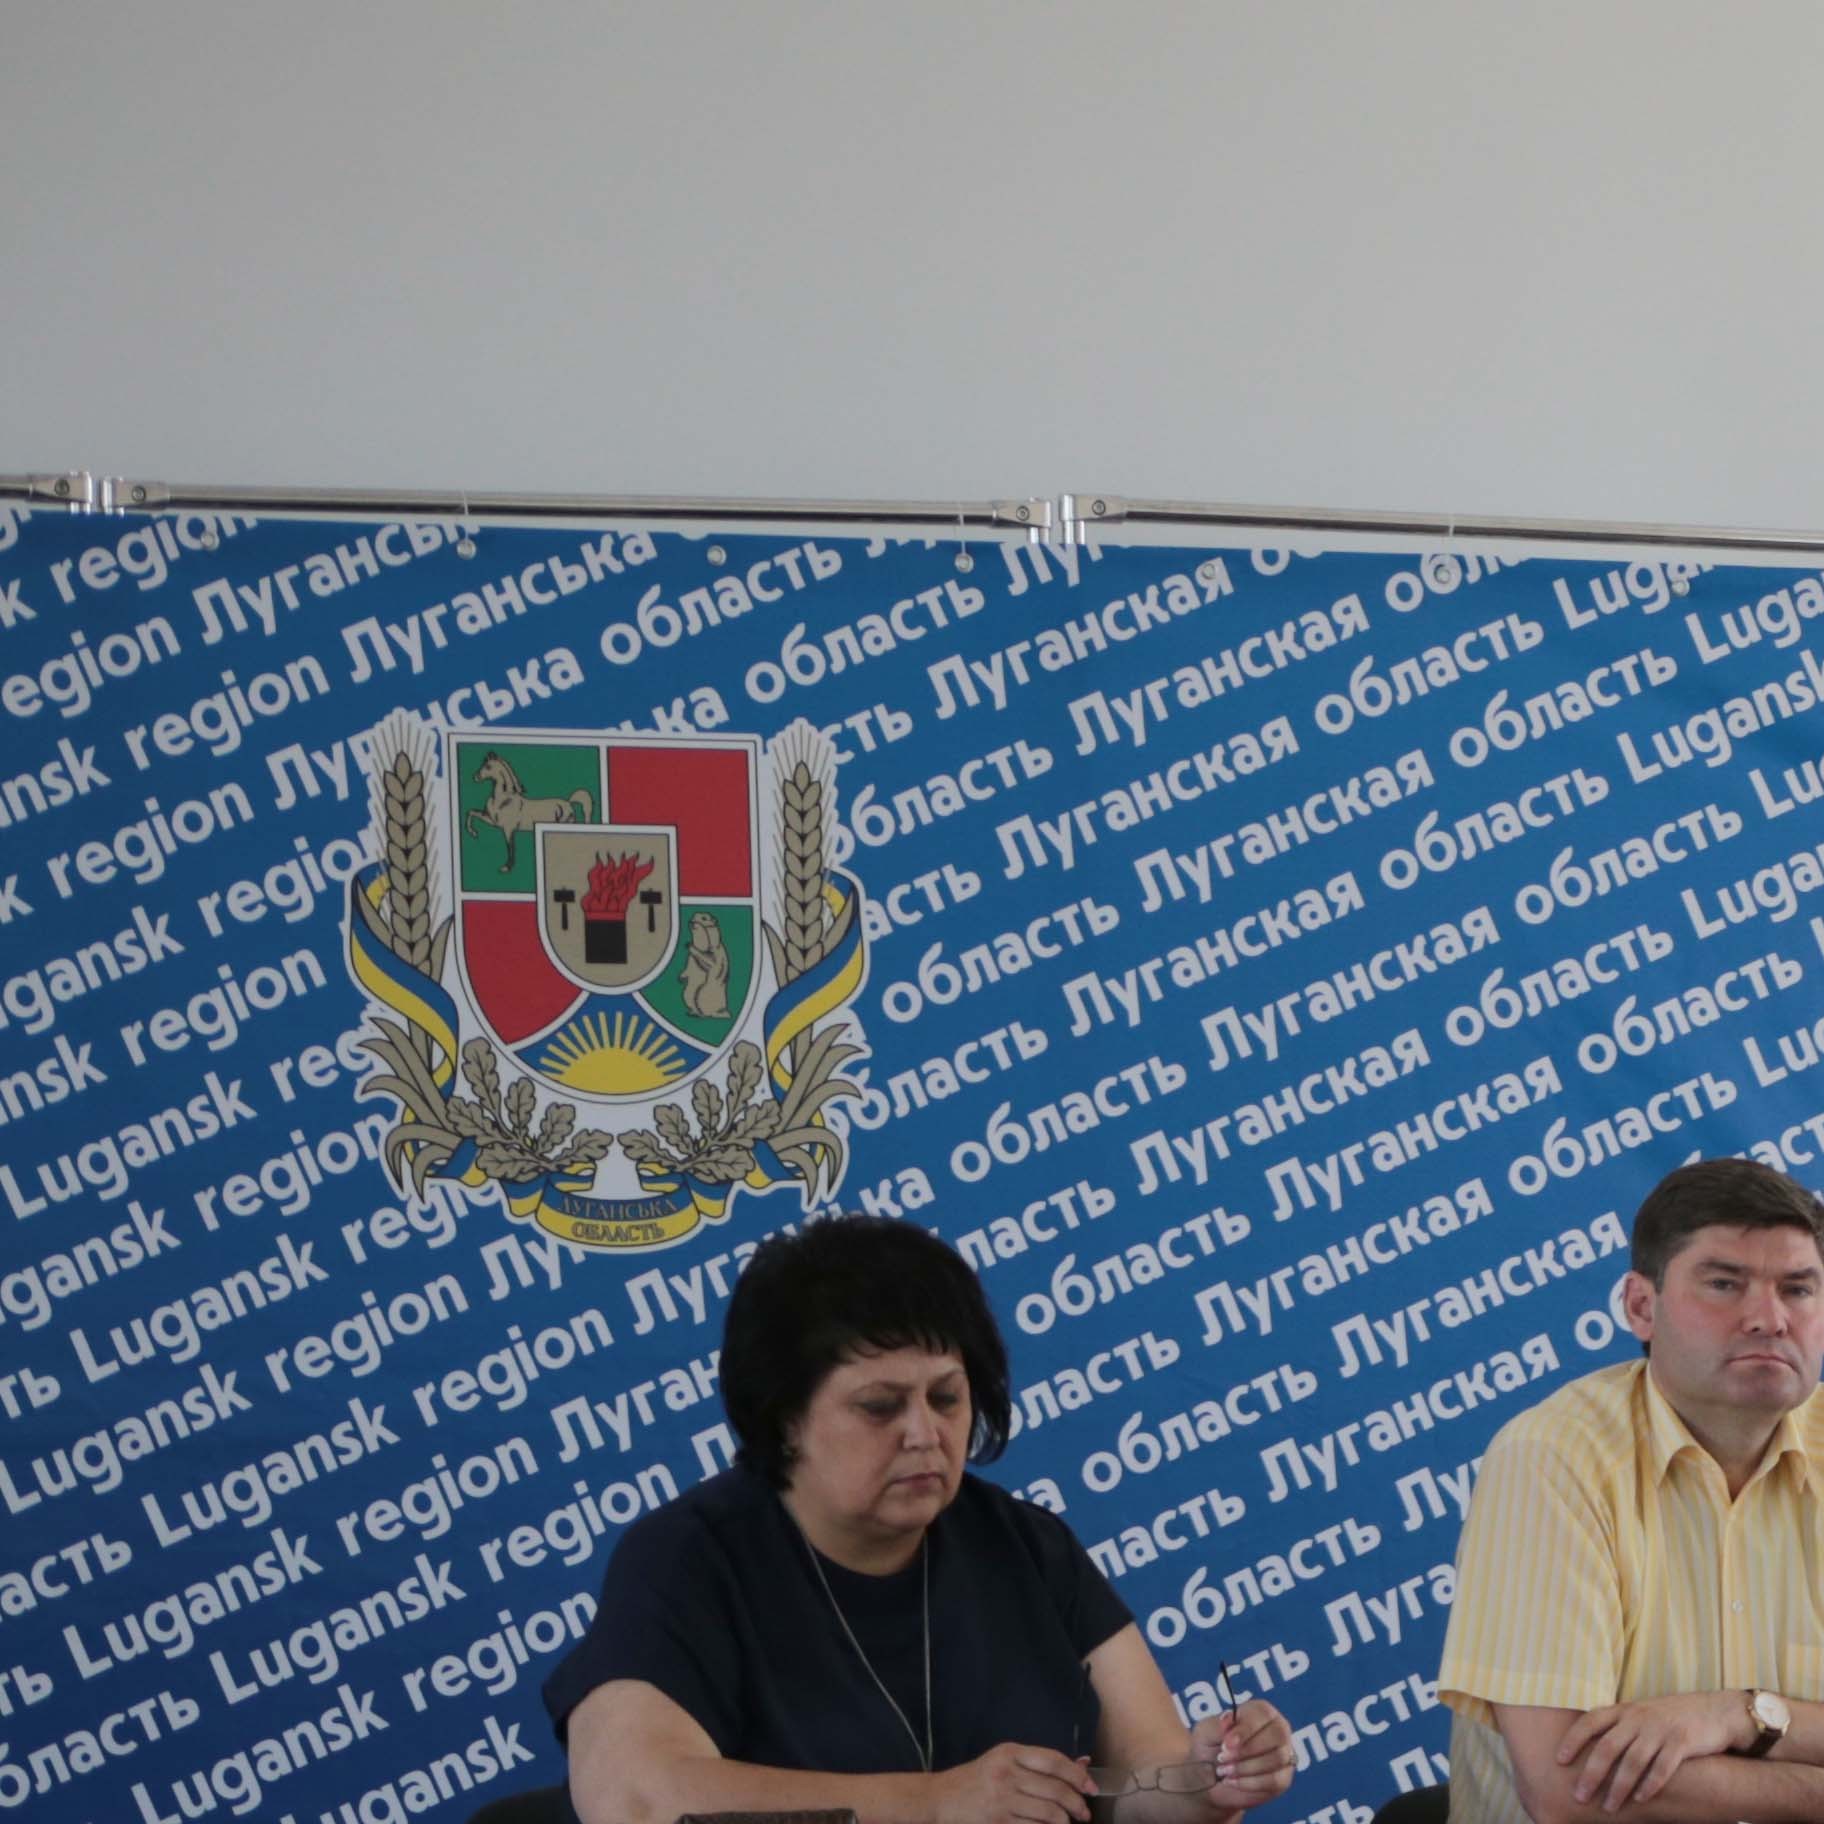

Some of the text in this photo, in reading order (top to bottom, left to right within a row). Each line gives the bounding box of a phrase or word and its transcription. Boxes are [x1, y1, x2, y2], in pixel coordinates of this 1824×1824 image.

[0, 906, 184, 1035] gansk
[745, 546, 985, 703] область
[0, 1072, 257, 1219] Lugansk
[1068, 594, 1370, 756] Луганская
[47, 783, 254, 897] region
[600, 542, 842, 665] область
[120, 949, 326, 1066] region
[927, 558, 1234, 719] Луганская
[124, 533, 656, 770] region Луганська
[0, 1200, 181, 1331] gansk
[996, 716, 1300, 880] Луганская
[1314, 613, 1544, 735] область
[0, 1363, 252, 1514] Lugansk
[265, 1274, 469, 1392] region
[1062, 872, 1365, 1037] Луганская
[1380, 768, 1609, 889] область
[70, 1233, 329, 1383] Lugansk
[882, 897, 1120, 1023] область
[1134, 749, 1435, 912] Луганская
[1449, 648, 1677, 767] область
[141, 1397, 400, 1547] Lugansk
[412, 1309, 614, 1426] region
[950, 1056, 1187, 1182] область
[1200, 906, 1500, 1071] Луганская
[1515, 804, 1743, 924] область
[557, 1196, 678, 1219] ЛУГАНСЬКА
[63, 1528, 323, 1679] Lugansk
[336, 1437, 539, 1556] region
[1130, 1028, 1431, 1195] Луганская
[1445, 924, 1674, 1046] область
[209, 1553, 466, 1705] Lugansk
[479, 1464, 680, 1582] region
[1015, 1207, 1251, 1334] область
[1265, 1056, 1563, 1222] Луганская
[1577, 952, 1803, 1074] область
[402, 1592, 591, 1712] region
[1194, 1178, 1494, 1346] Луганская
[1507, 1072, 1738, 1198] область
[1082, 1364, 1318, 1492] область
[1331, 1211, 1628, 1378] Луганская
[1147, 1517, 1381, 1648] область
[1260, 1333, 1560, 1502] Луганская
